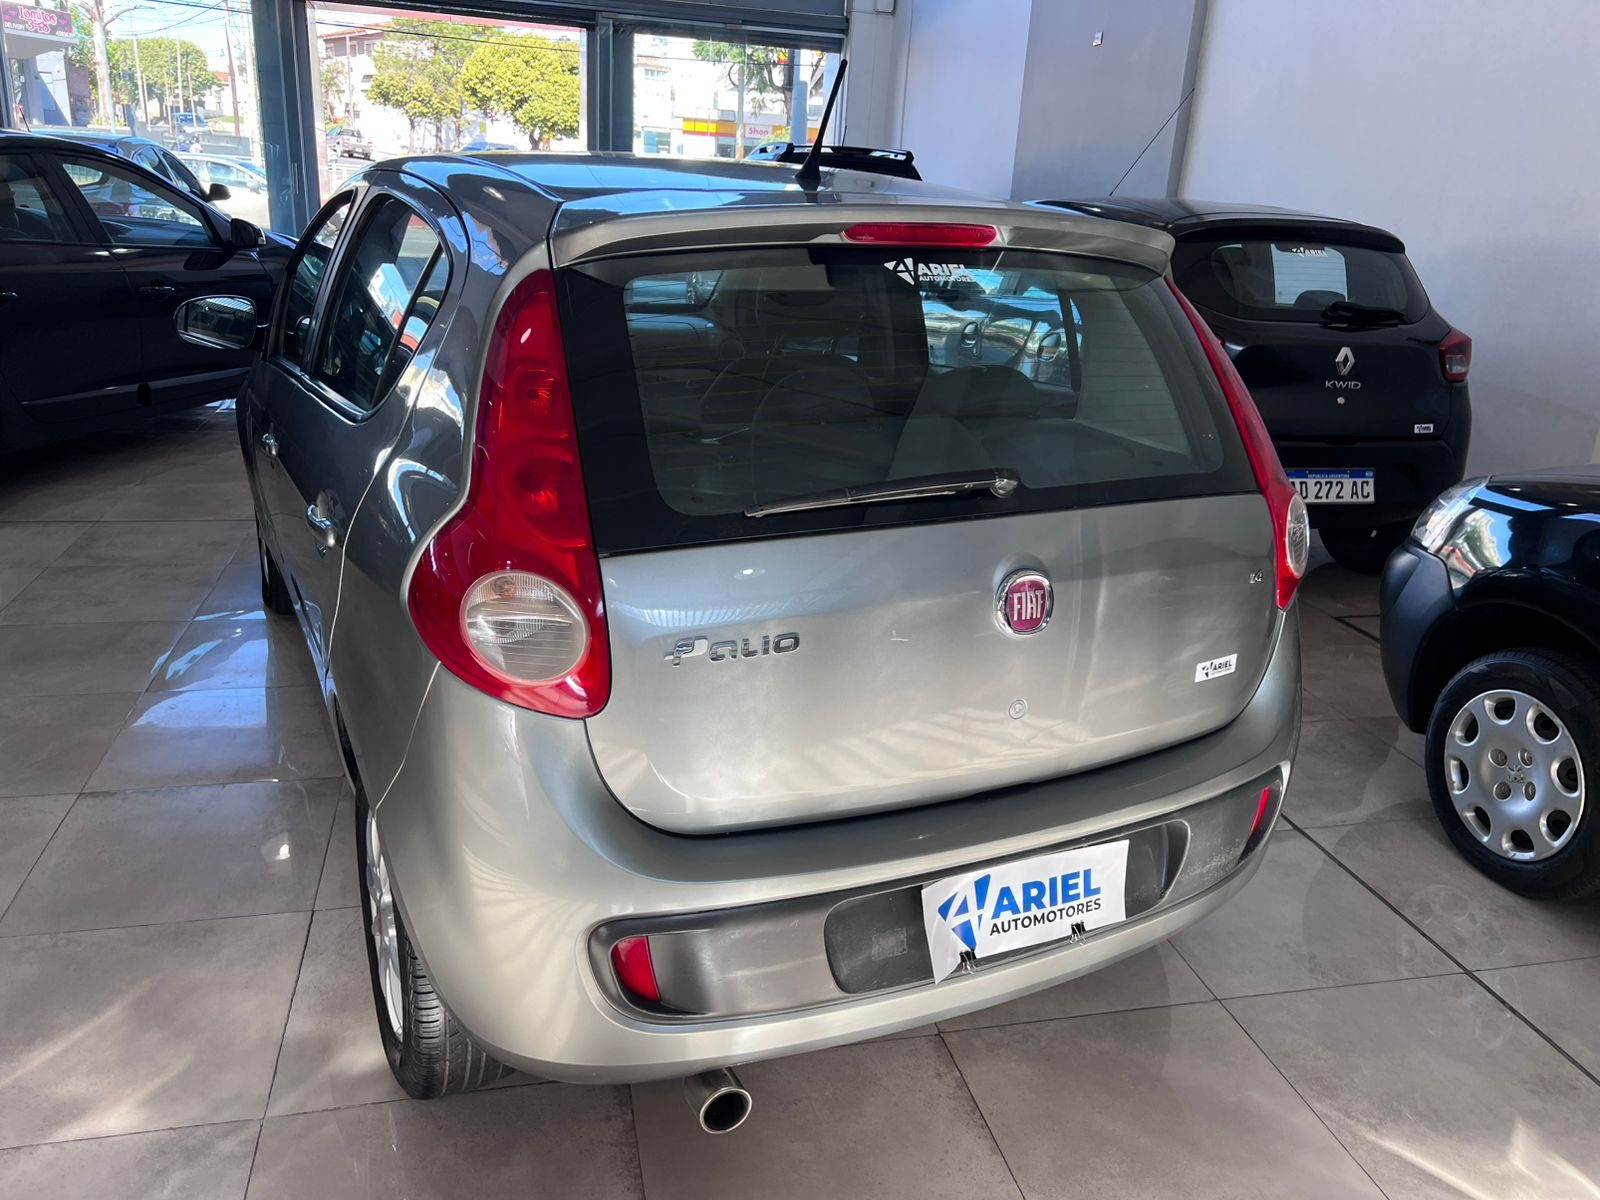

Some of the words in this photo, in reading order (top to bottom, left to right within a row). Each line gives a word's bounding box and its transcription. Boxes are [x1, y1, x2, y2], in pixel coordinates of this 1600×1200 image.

[4, 22, 25, 30] DELIVERY
[1325, 380, 1361, 389] KWID
[1314, 480, 1344, 499] 272
[1350, 480, 1370, 499] AC
[1013, 589, 1044, 622] FIAT
[1212, 659, 1232, 671] ARIEL
[991, 868, 1102, 920] ARIEL
[989, 898, 1102, 937] AUTOMOTORES
